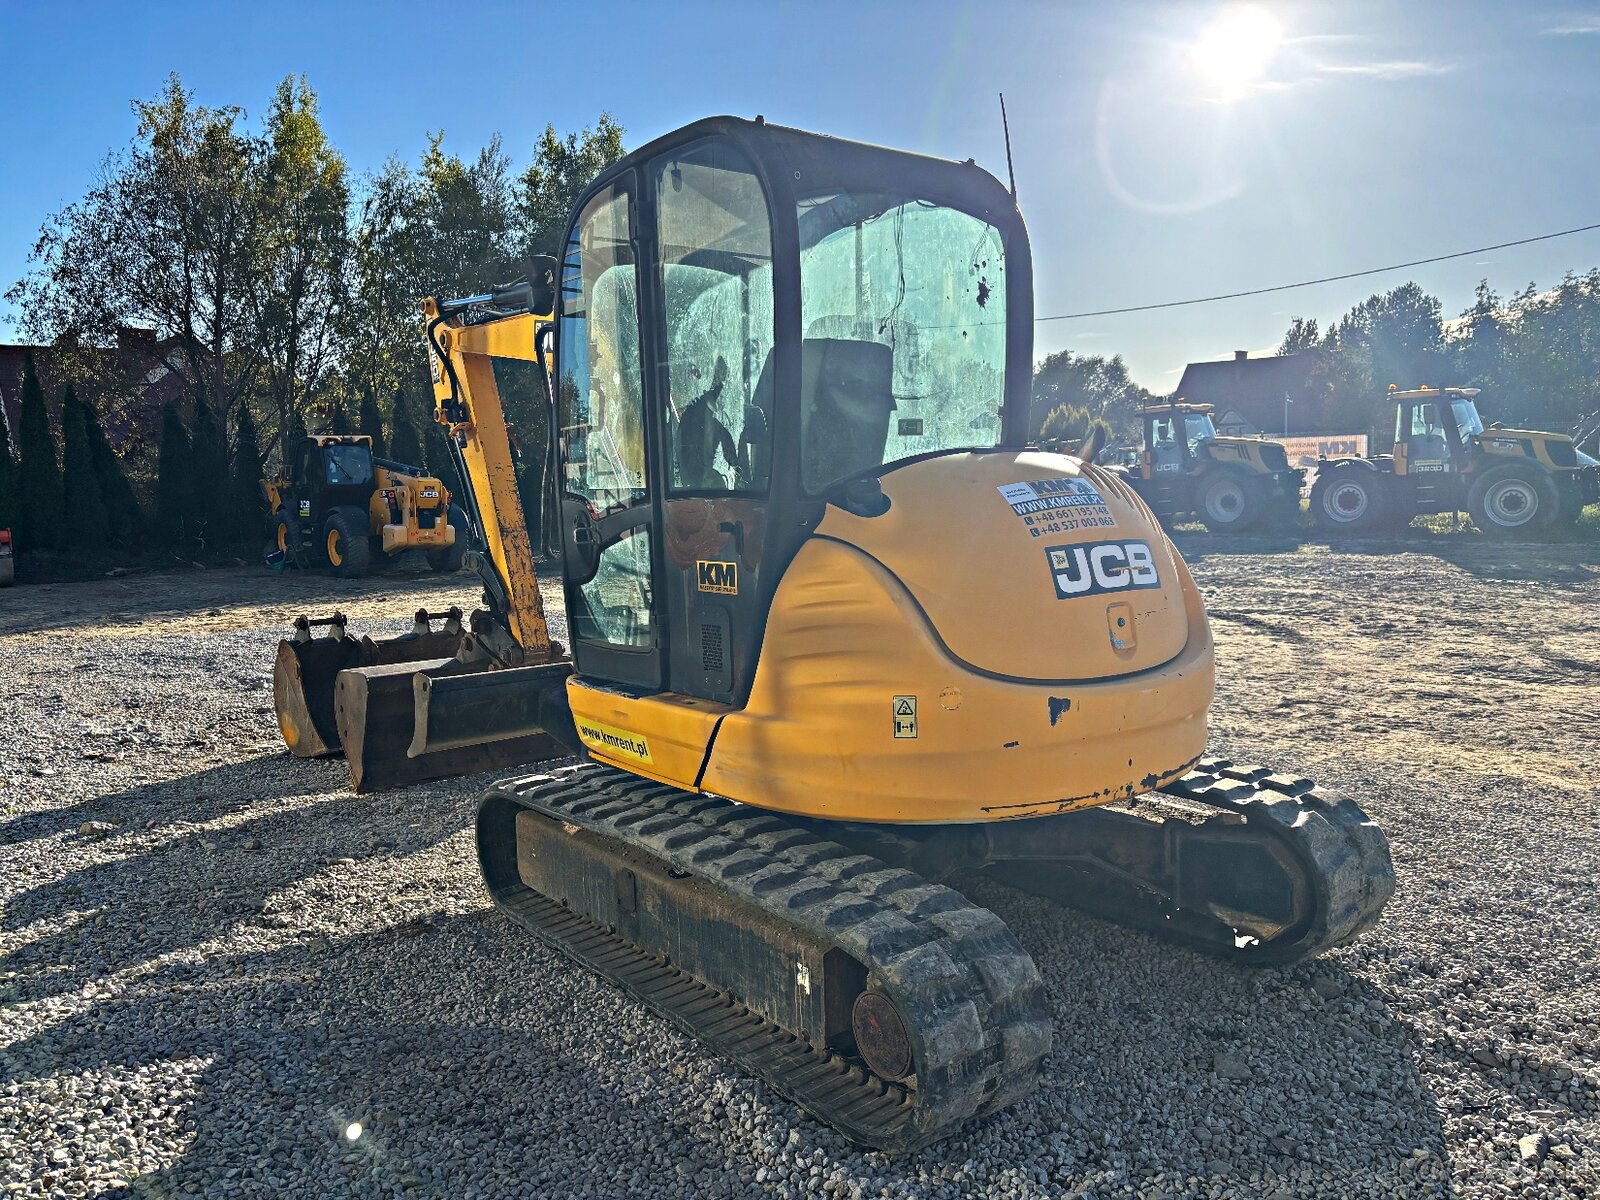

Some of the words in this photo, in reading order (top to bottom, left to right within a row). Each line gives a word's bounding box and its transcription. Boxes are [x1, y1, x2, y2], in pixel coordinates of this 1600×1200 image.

[1156, 463, 1179, 472] JCB
[1013, 494, 1104, 515] WWW.KMRENT.PL
[1036, 510, 1055, 524] +48
[1057, 508, 1073, 519] 661
[1077, 506, 1092, 517] 195
[1095, 506, 1109, 515] 148
[1041, 522, 1061, 536] +48
[1061, 519, 1080, 531] 537
[1081, 518, 1099, 528] 003
[1099, 516, 1114, 526] 063
[699, 563, 735, 588] KM
[1056, 543, 1158, 594] JCB
[579, 724, 649, 758] www.kmrent.pl
